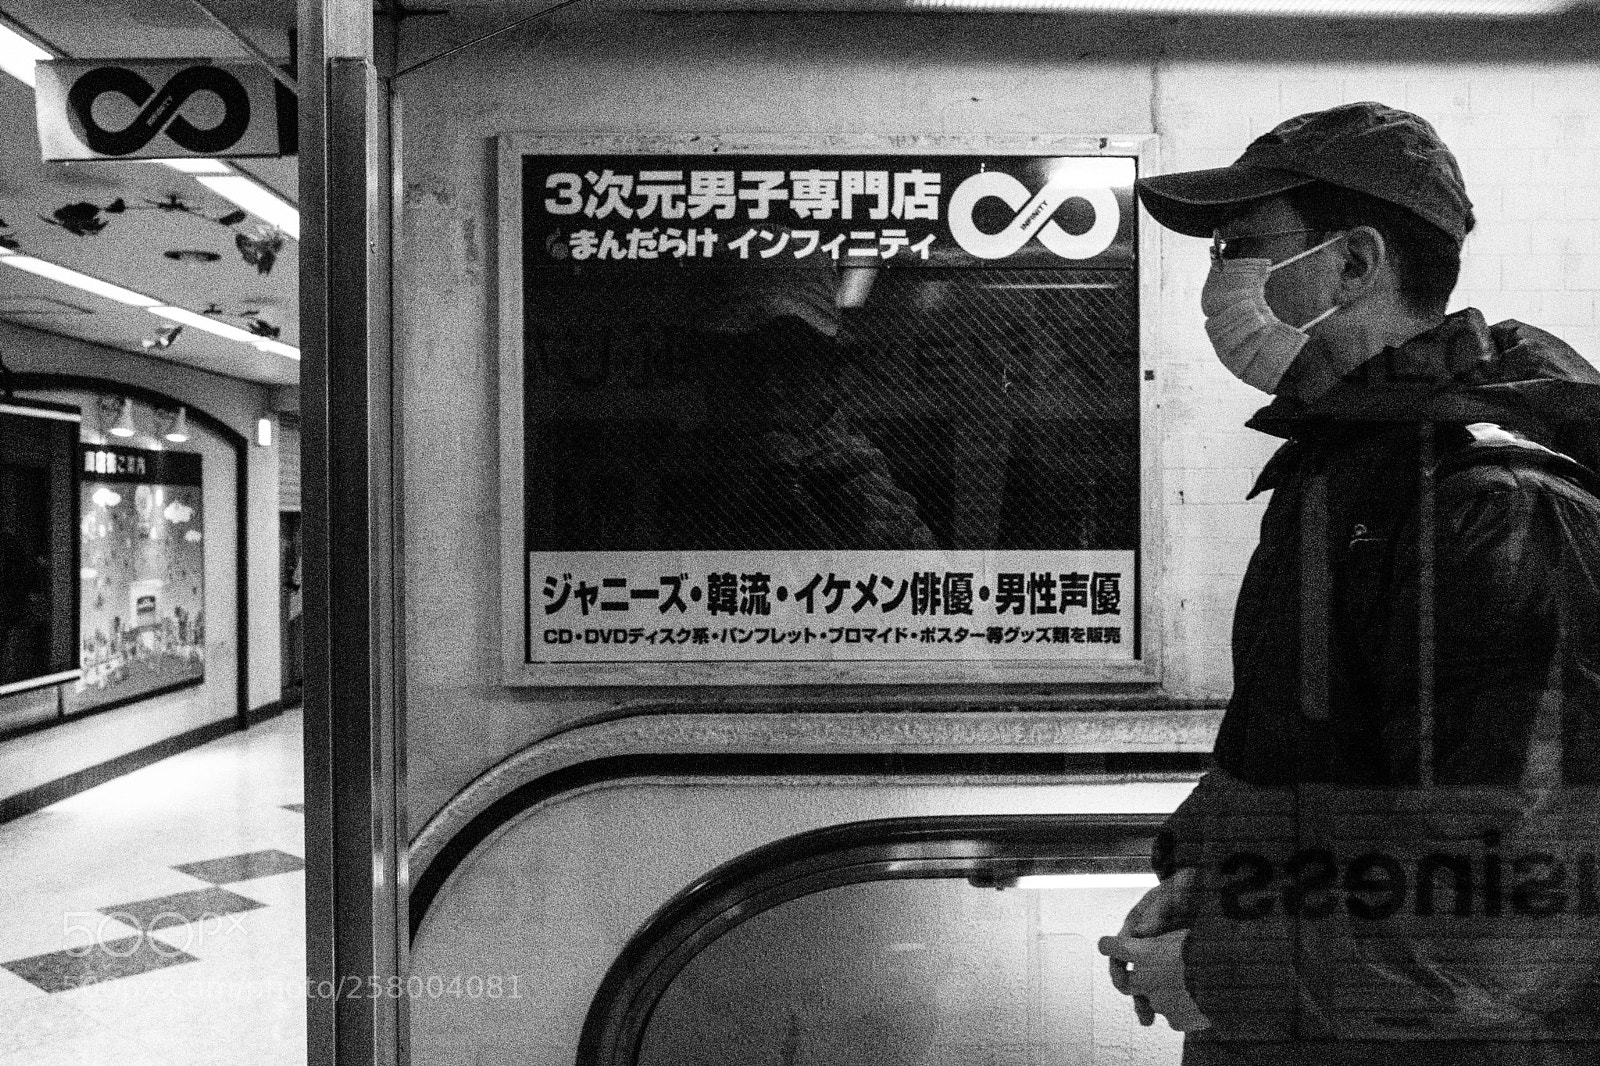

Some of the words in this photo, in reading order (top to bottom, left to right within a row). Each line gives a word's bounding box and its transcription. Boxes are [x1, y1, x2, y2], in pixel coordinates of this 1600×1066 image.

[545, 169, 942, 220] 3次元男子専門店
[1020, 200, 1049, 231] INFINITY
[569, 226, 719, 260] まんだらけ
[727, 228, 936, 260] インフィニティ
